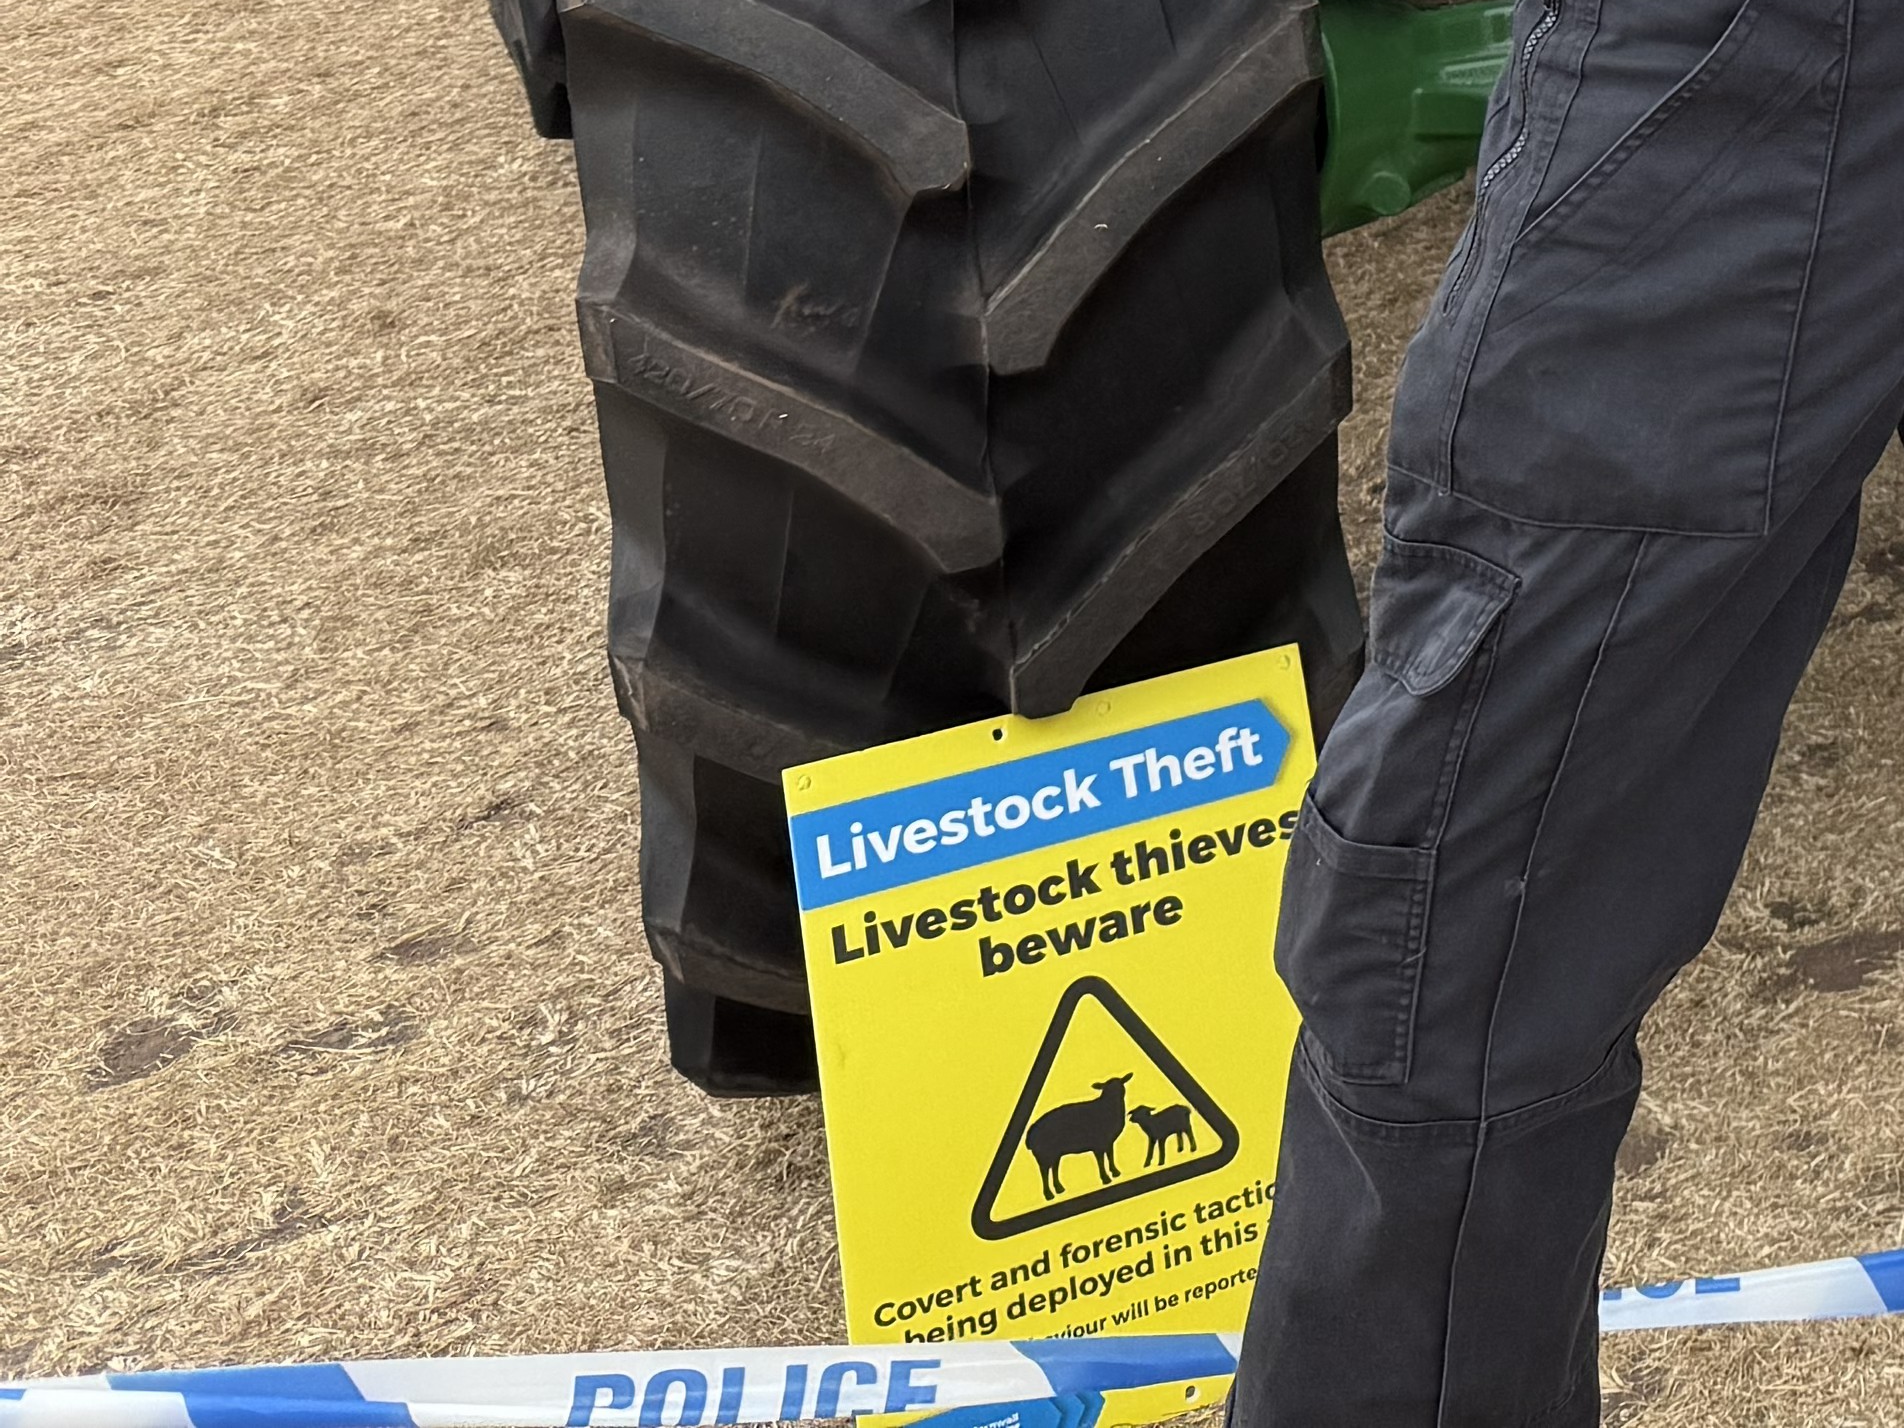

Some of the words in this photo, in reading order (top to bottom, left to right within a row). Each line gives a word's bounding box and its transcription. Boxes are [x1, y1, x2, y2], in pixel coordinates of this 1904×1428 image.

[815, 770, 1101, 878] Livestock
[1109, 726, 1263, 799] Theft
[831, 857, 1100, 965] Livestock
[1109, 807, 1300, 894] thieves
[978, 891, 1184, 978] beware
[873, 1275, 982, 1327] Covert
[990, 1250, 1051, 1291] and
[1059, 1210, 1187, 1267] forensic
[1006, 1250, 1155, 1321] deployed
[1163, 1244, 1193, 1269] in
[1200, 1220, 1259, 1256] this
[1111, 1301, 1150, 1330] will
[1154, 1291, 1180, 1312] be
